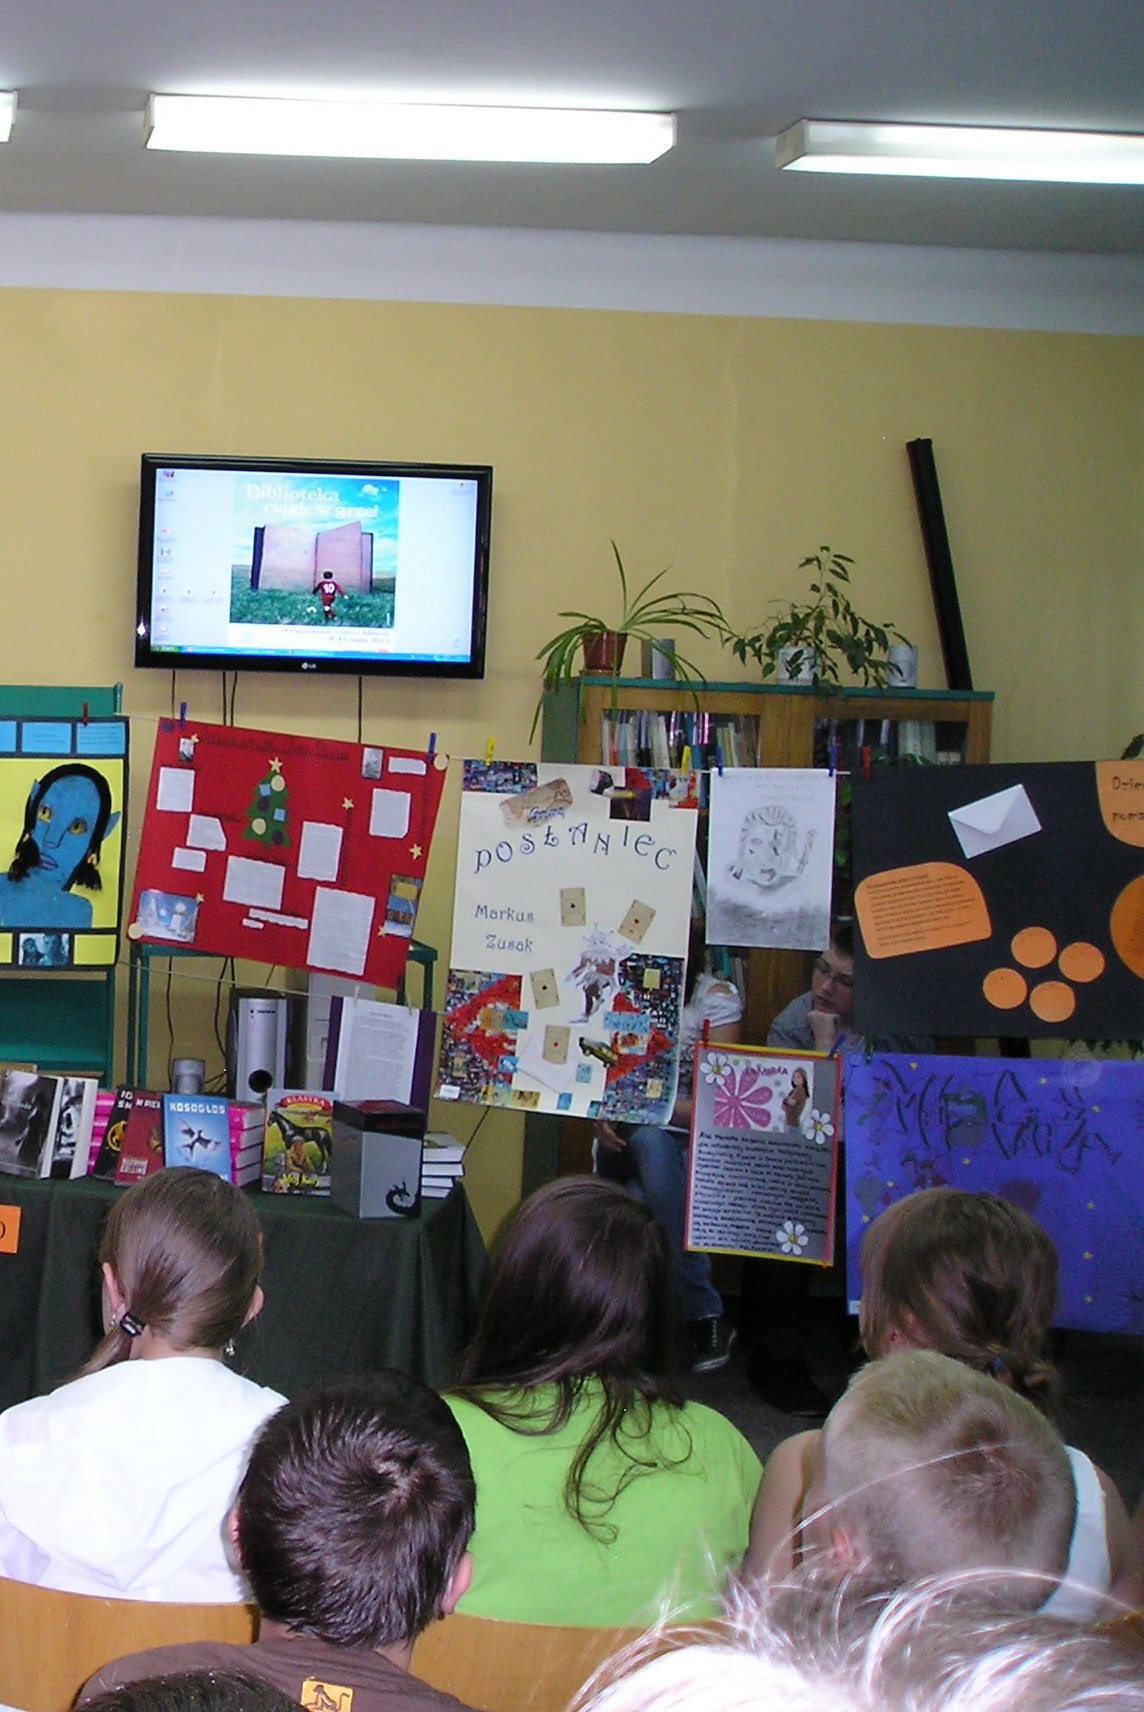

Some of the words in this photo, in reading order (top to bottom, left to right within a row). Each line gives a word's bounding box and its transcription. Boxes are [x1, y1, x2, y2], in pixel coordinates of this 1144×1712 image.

[245, 483, 340, 502] Biblioteka
[475, 904, 534, 922] Markus
[485, 934, 533, 952] Zusak
